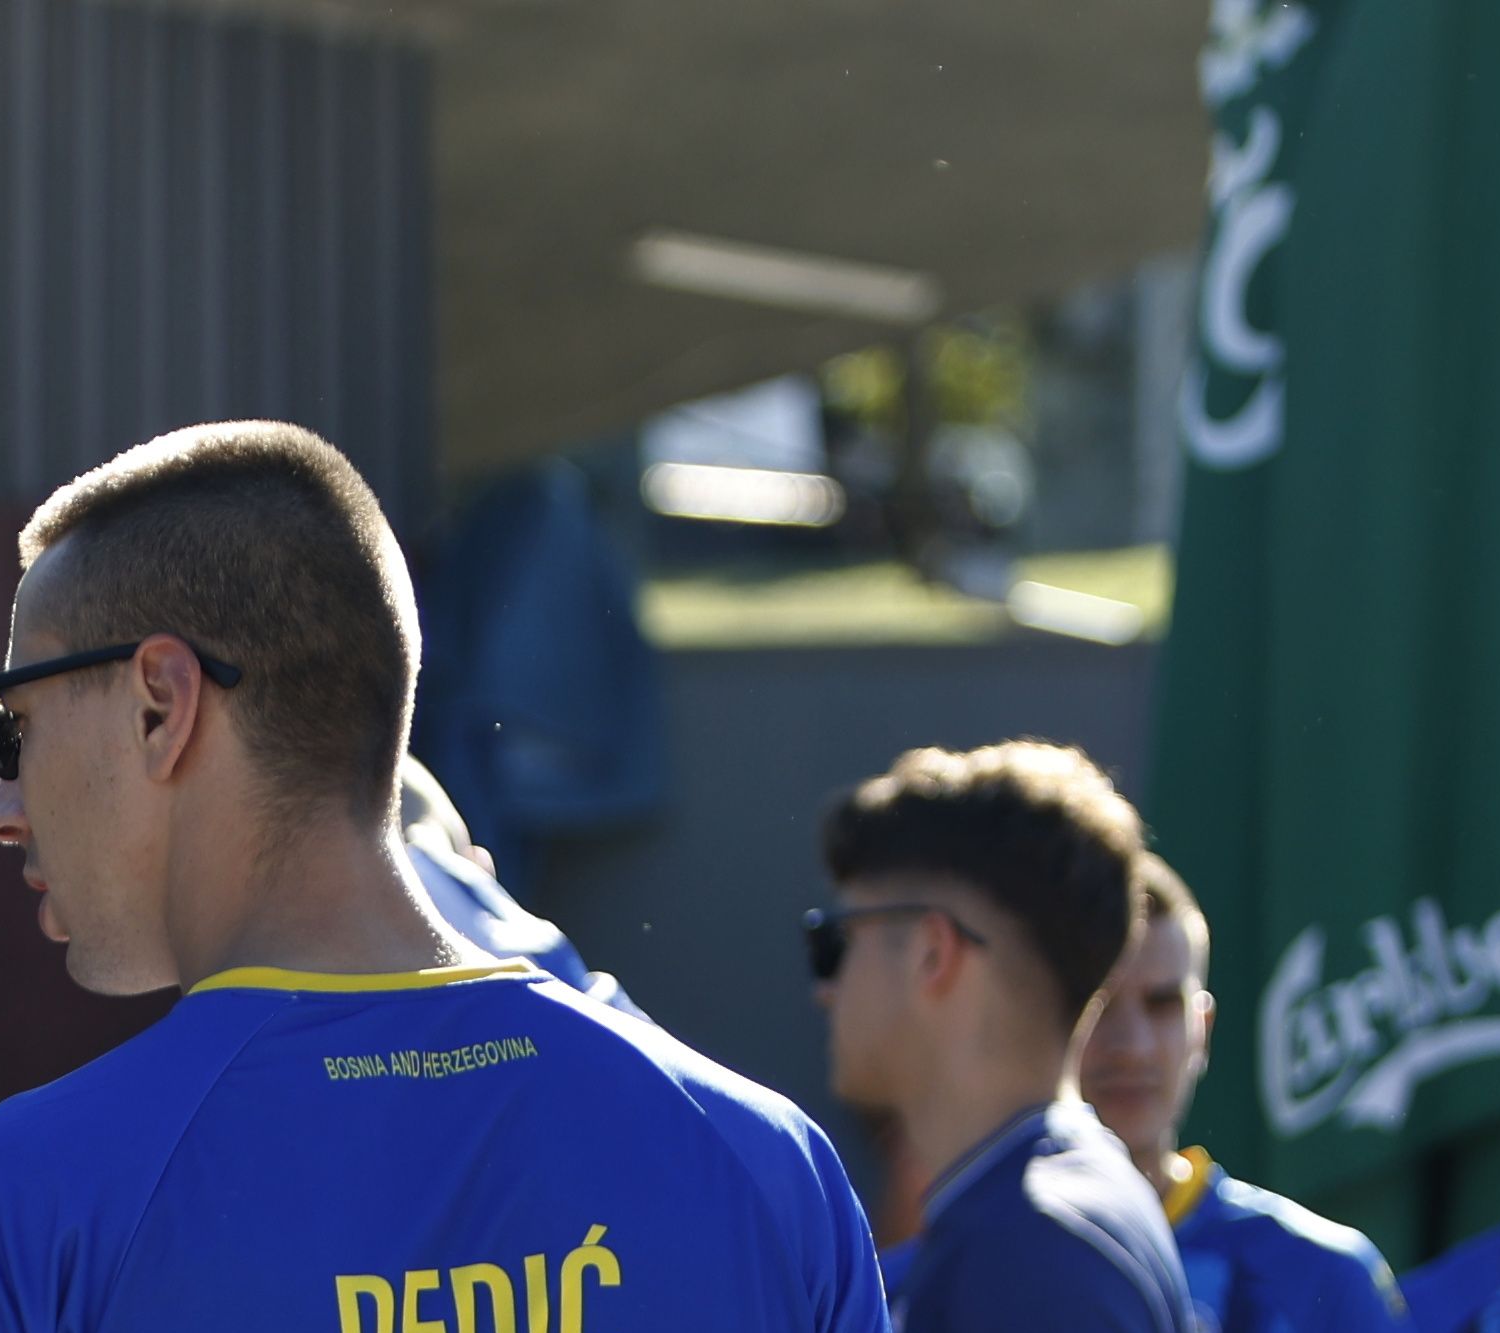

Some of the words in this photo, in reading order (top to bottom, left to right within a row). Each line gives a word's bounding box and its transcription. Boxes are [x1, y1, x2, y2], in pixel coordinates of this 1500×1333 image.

[324, 1055, 388, 1080] BOSNIA
[390, 1050, 420, 1078] AND
[422, 1035, 538, 1078] HERZEGOVINA
